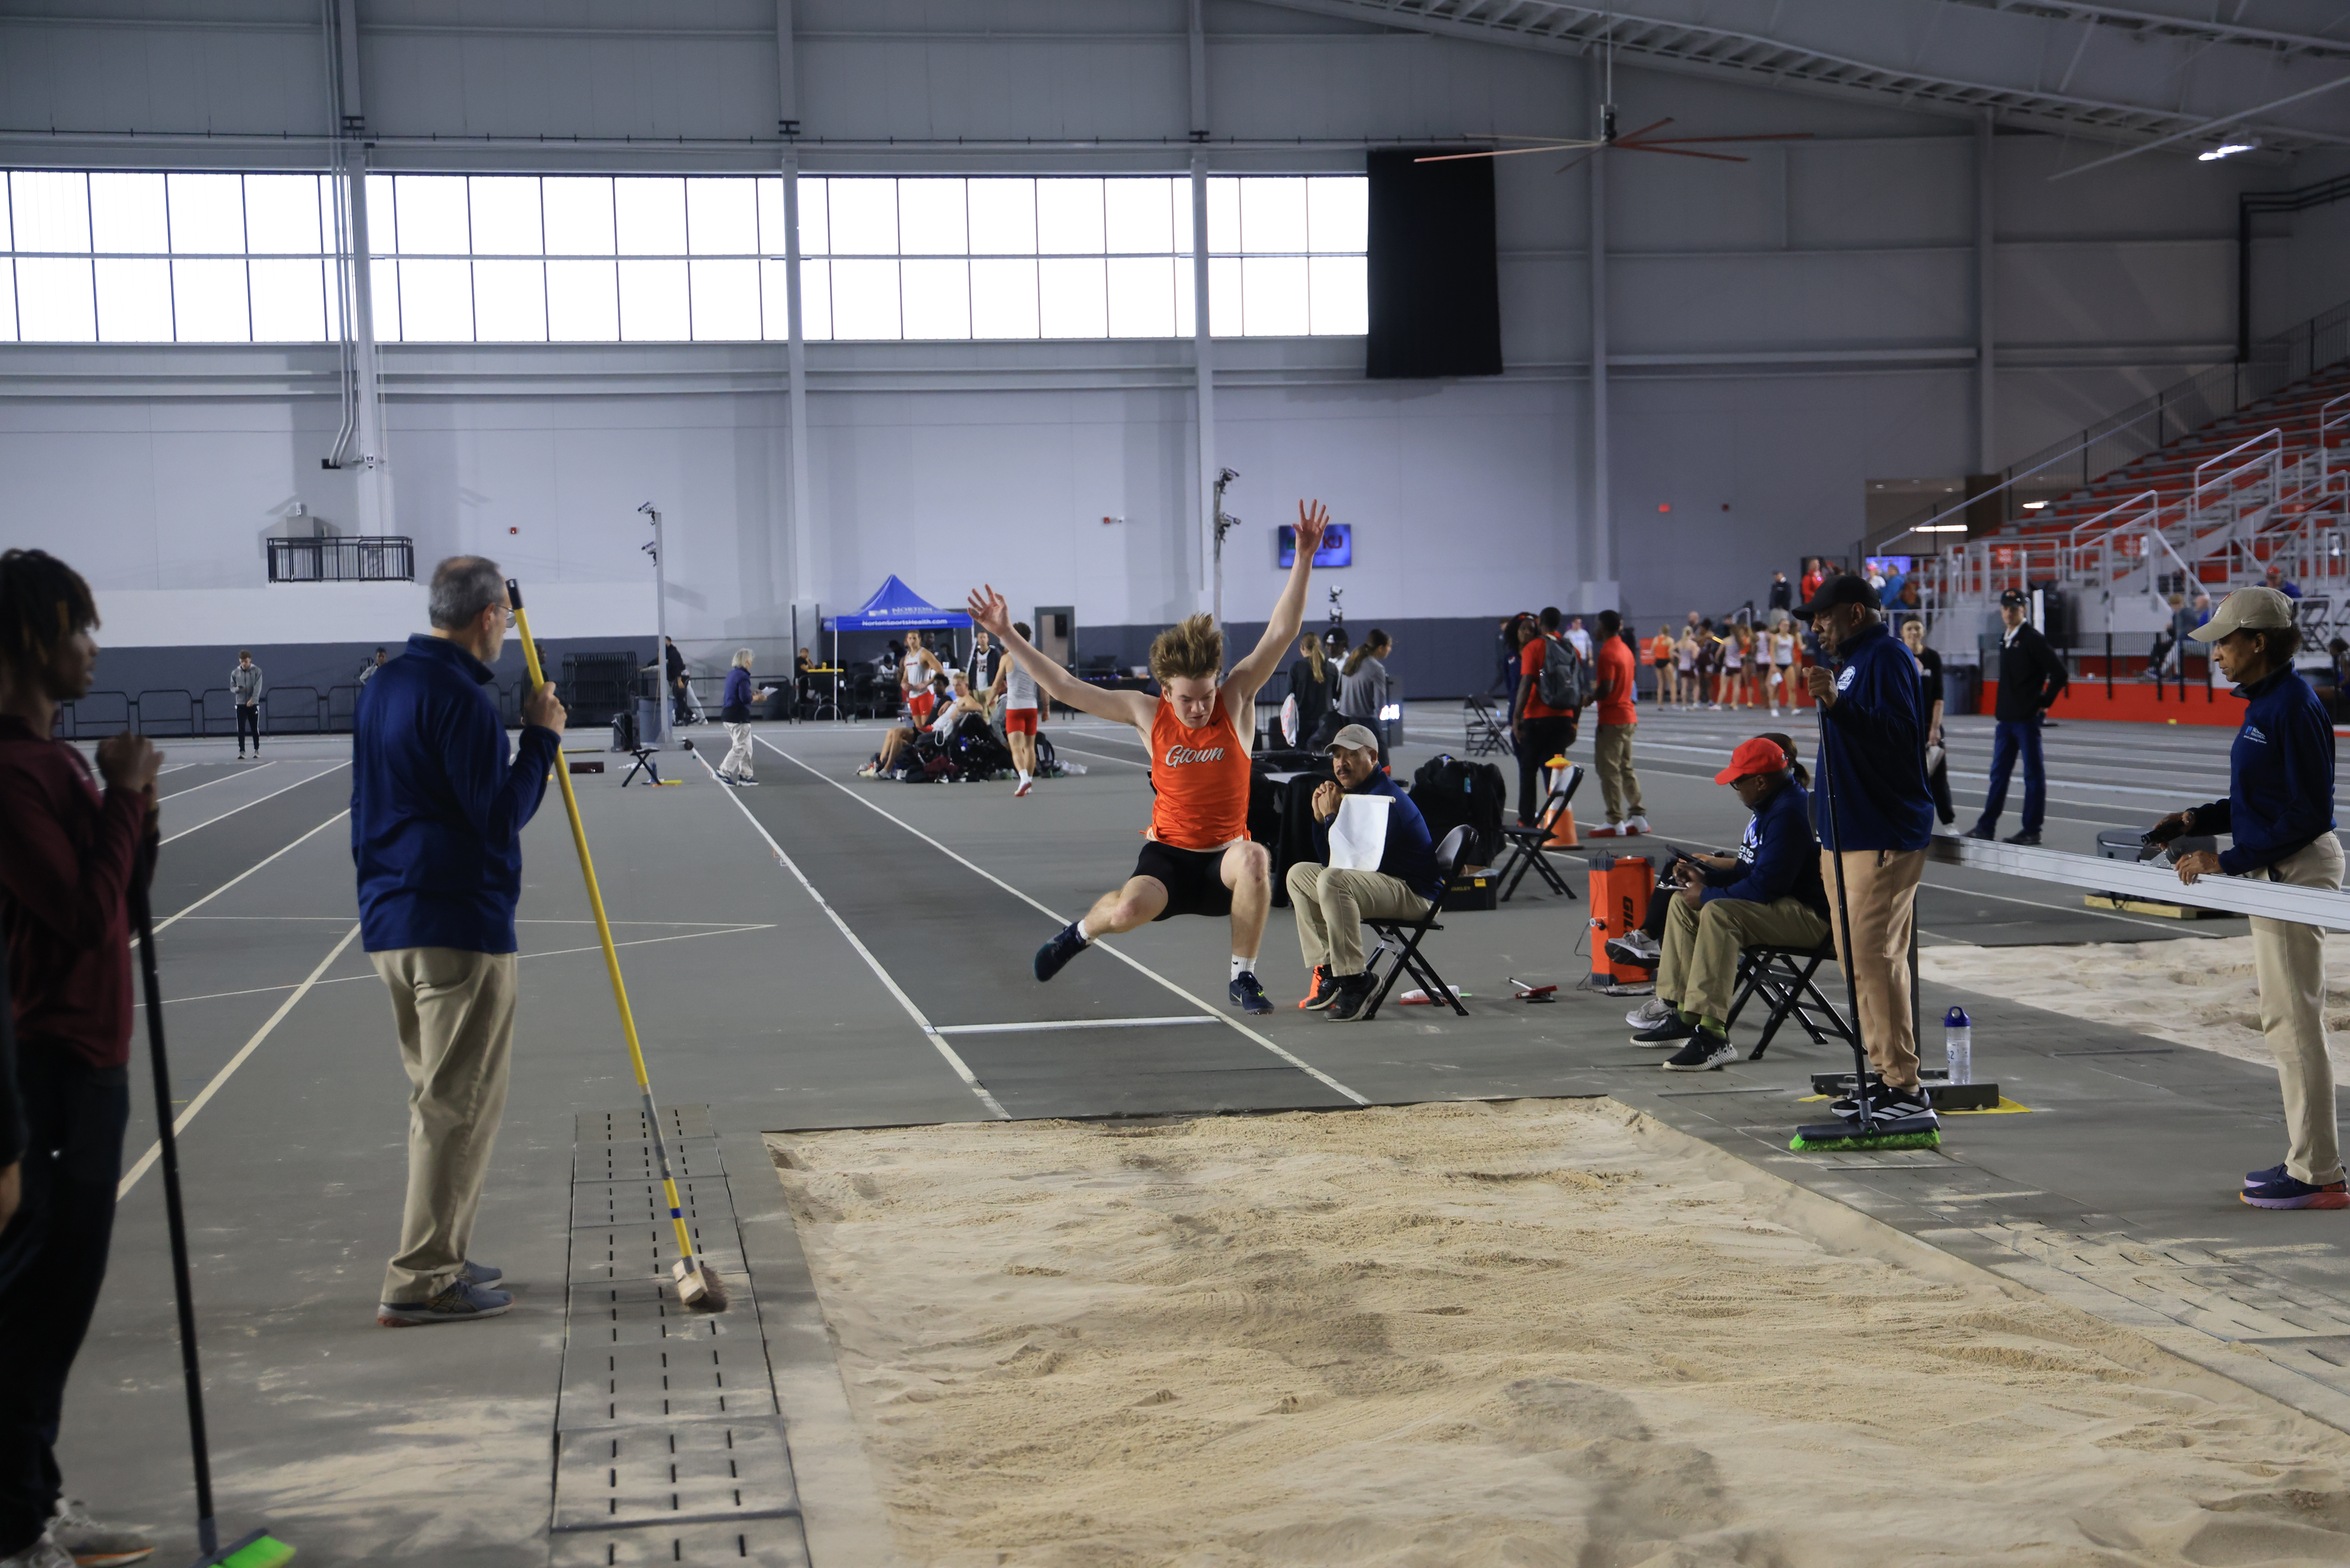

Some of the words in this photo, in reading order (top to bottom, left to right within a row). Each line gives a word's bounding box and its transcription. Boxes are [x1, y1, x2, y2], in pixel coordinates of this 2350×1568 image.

[892, 606, 932, 614] NORTON
[861, 618, 948, 627] NortonSportsHealth.com
[1165, 744, 1226, 769] Gtown
[1623, 896, 1634, 934] GIL
